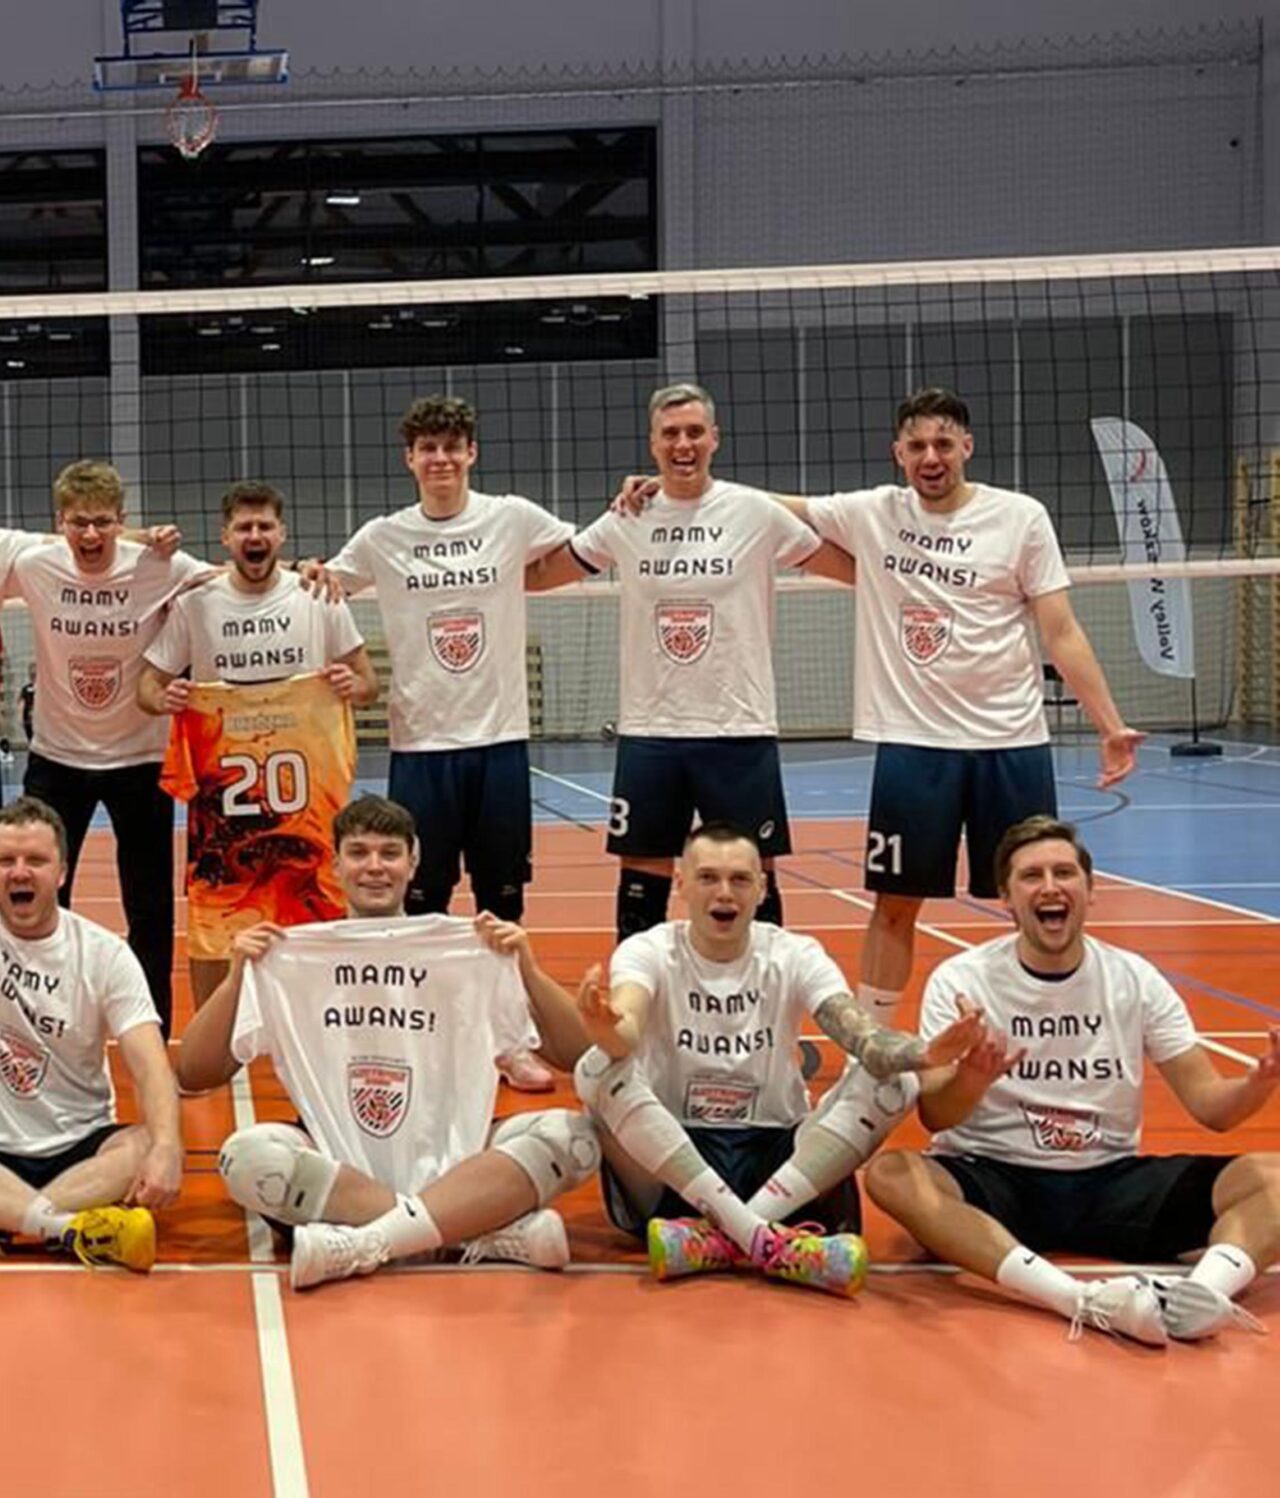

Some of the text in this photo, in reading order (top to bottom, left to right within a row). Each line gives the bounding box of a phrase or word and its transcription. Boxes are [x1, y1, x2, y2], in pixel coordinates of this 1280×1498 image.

[651, 526, 723, 543] MAMY
[898, 528, 972, 554] MAMY
[413, 537, 482, 558] MAMY
[406, 567, 497, 590] AWANS!
[639, 558, 733, 576] AWANS!
[884, 554, 977, 588] AWANS!
[61, 588, 128, 606] MAMY
[51, 617, 139, 637] AWANS!
[222, 616, 290, 637] MAMY
[214, 647, 304, 669] AWANS!
[220, 752, 309, 816] 20
[867, 830, 902, 875] 21
[335, 964, 427, 988] MAMY
[688, 988, 760, 1014] MAMY
[324, 1005, 436, 1033] AWANS!
[1011, 1014, 1102, 1037] MAMY
[1005, 1057, 1124, 1080] WANS!
